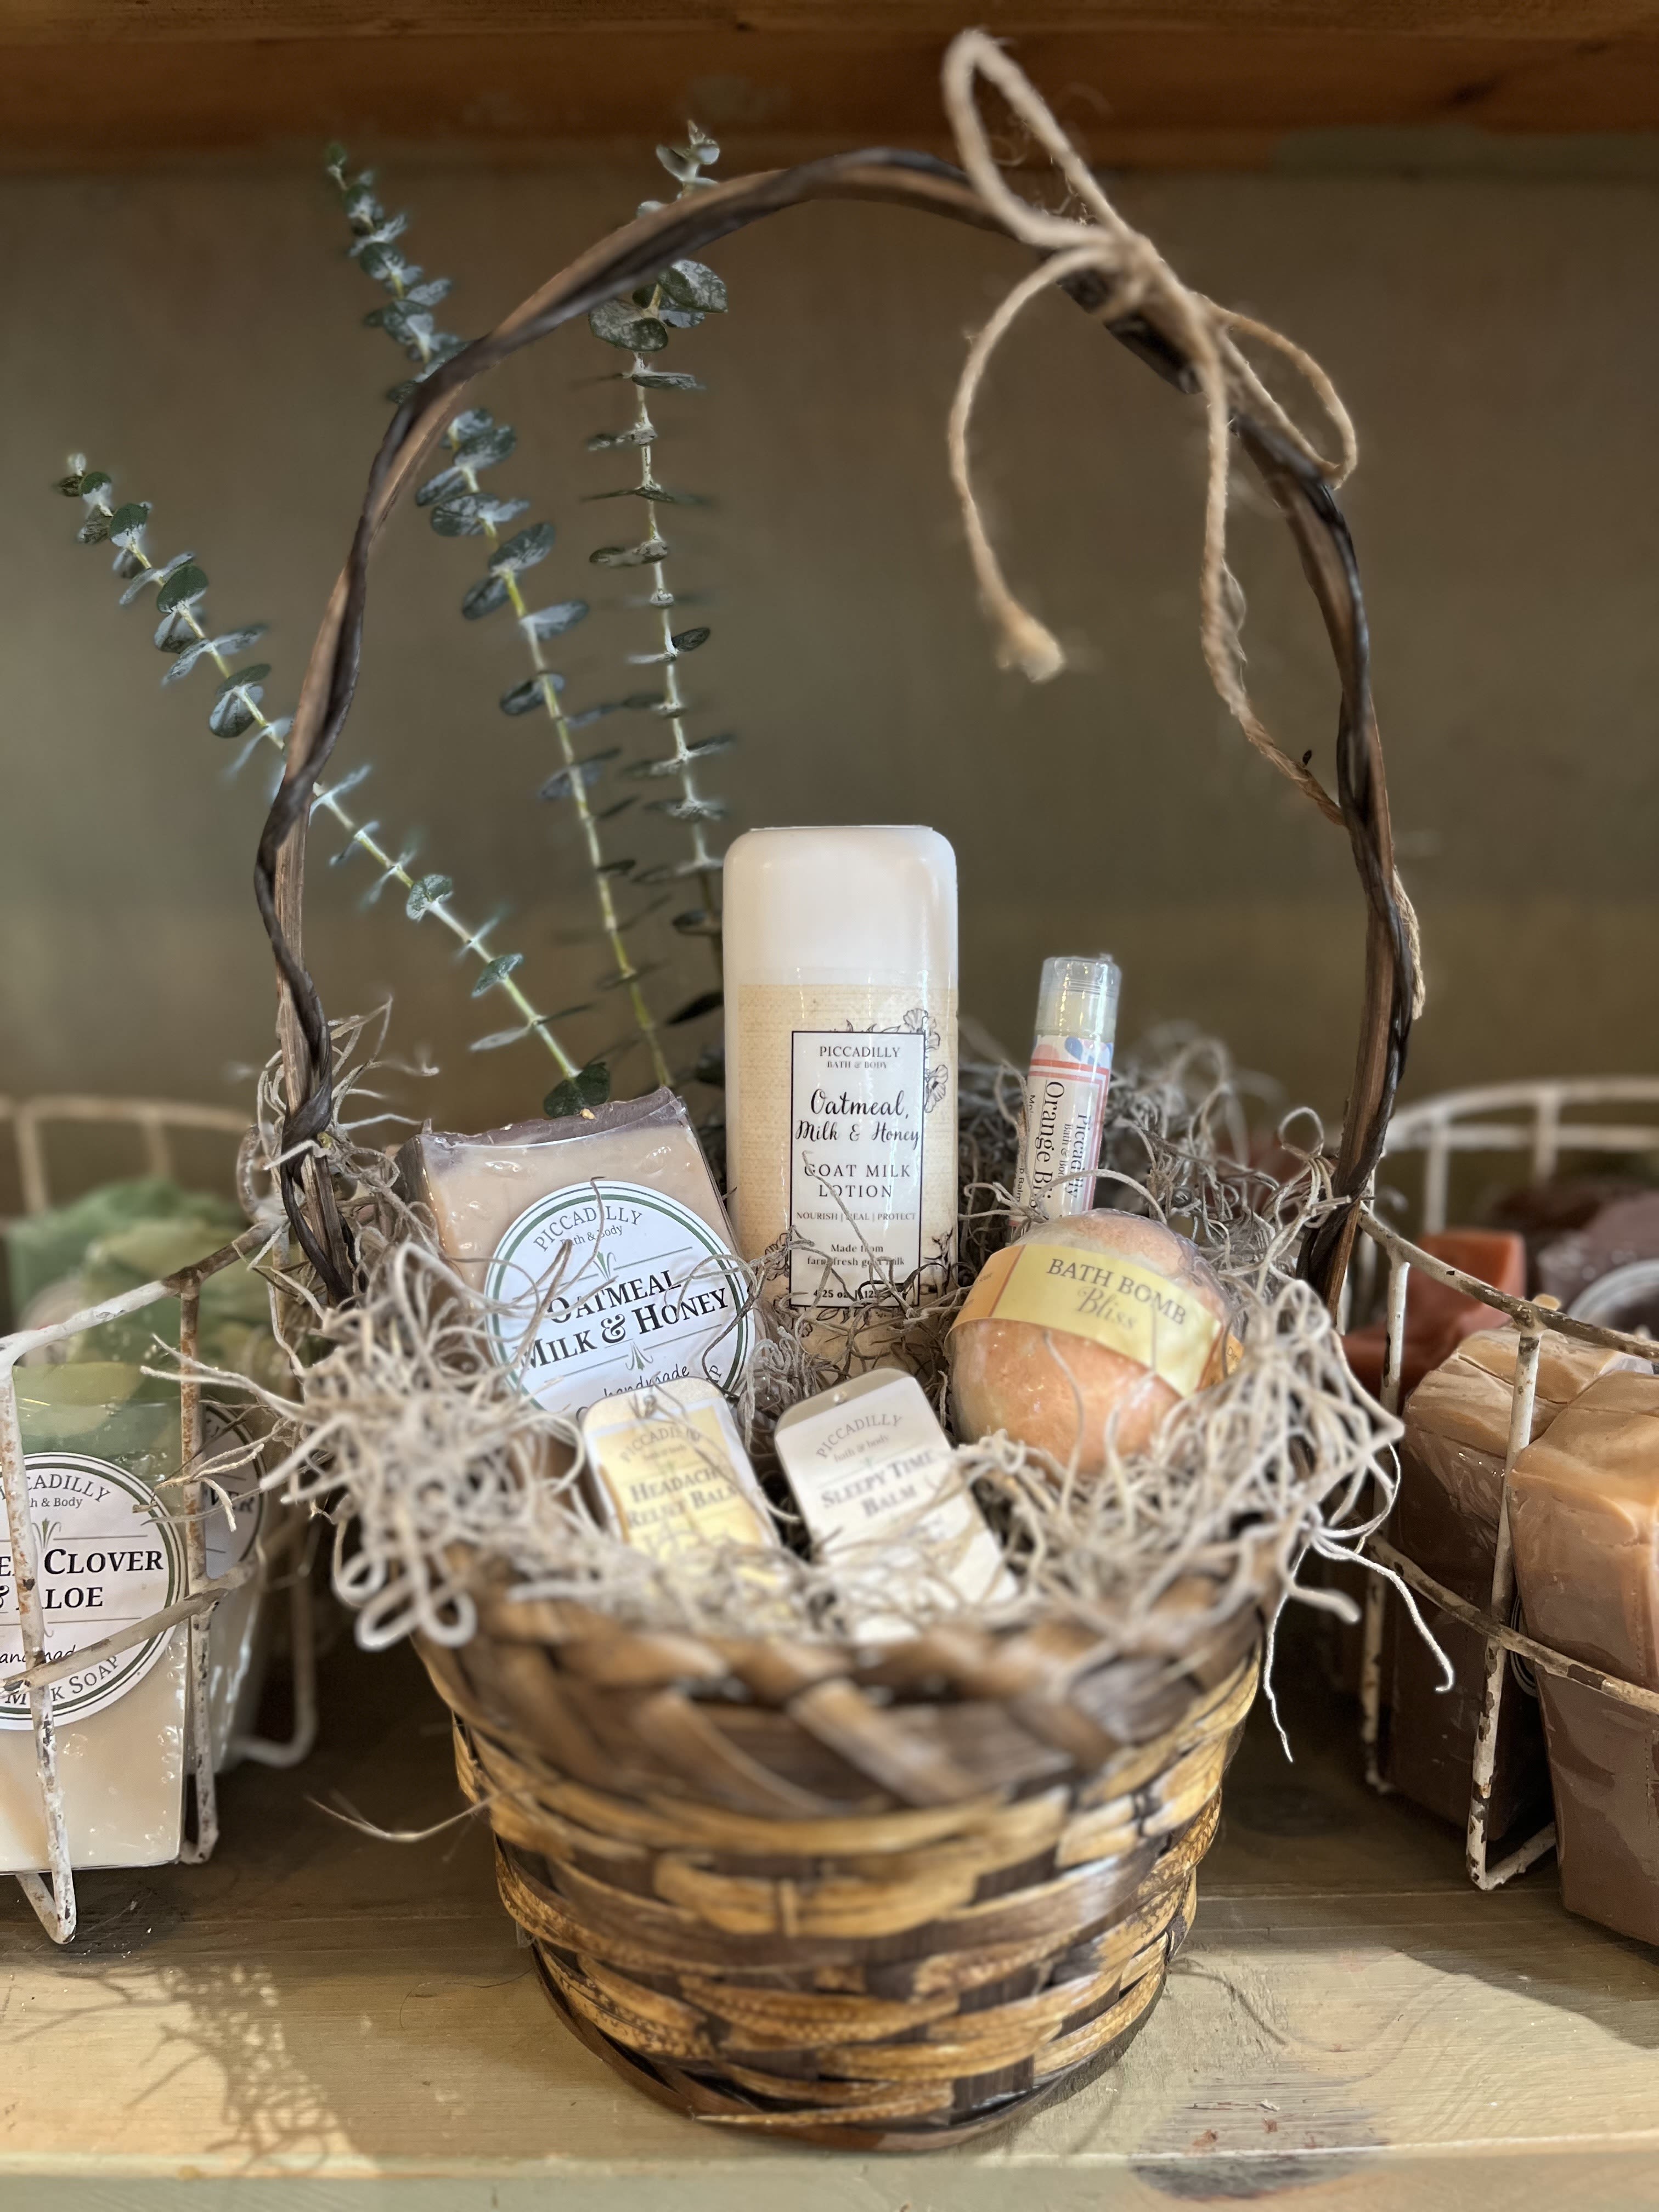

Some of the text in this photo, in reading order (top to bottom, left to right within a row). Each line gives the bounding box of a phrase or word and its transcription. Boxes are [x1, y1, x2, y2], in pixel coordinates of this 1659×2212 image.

[820, 1046, 900, 1058] PICCADILLY
[810, 1088, 909, 1119] Oatmeal,
[795, 1120, 921, 1150] Milk & Honey
[1035, 1081, 1065, 1163] Orange
[804, 1164, 911, 1177] GOAT MILK
[1066, 1114, 1092, 1198] Piccadlly
[819, 1185, 893, 1198] LOTION
[533, 1206, 642, 1252] PICCADLLY
[877, 1212, 916, 1221] PROTECT
[560, 1234, 585, 1245] Bth
[588, 1232, 595, 1241] &
[831, 1244, 883, 1252] Made fom
[833, 1256, 858, 1266] fresh
[548, 1270, 681, 1323] OATMEAL
[1046, 1259, 1187, 1325] BATH BOMB
[1076, 1285, 1137, 1330] Bliss
[513, 1288, 729, 1368] MILK & HONEY
[816, 1414, 902, 1459] PICCADILLY
[629, 1464, 724, 1504] HEADACH
[821, 1451, 932, 1508] SLEEPY TIME
[41, 1498, 50, 1507] &
[53, 1497, 82, 1509] Body
[861, 1484, 917, 1517] BALM
[44, 1549, 163, 1575] CLOVER
[16, 1586, 103, 1610] LOE
[69, 1656, 119, 1694] SOAP
